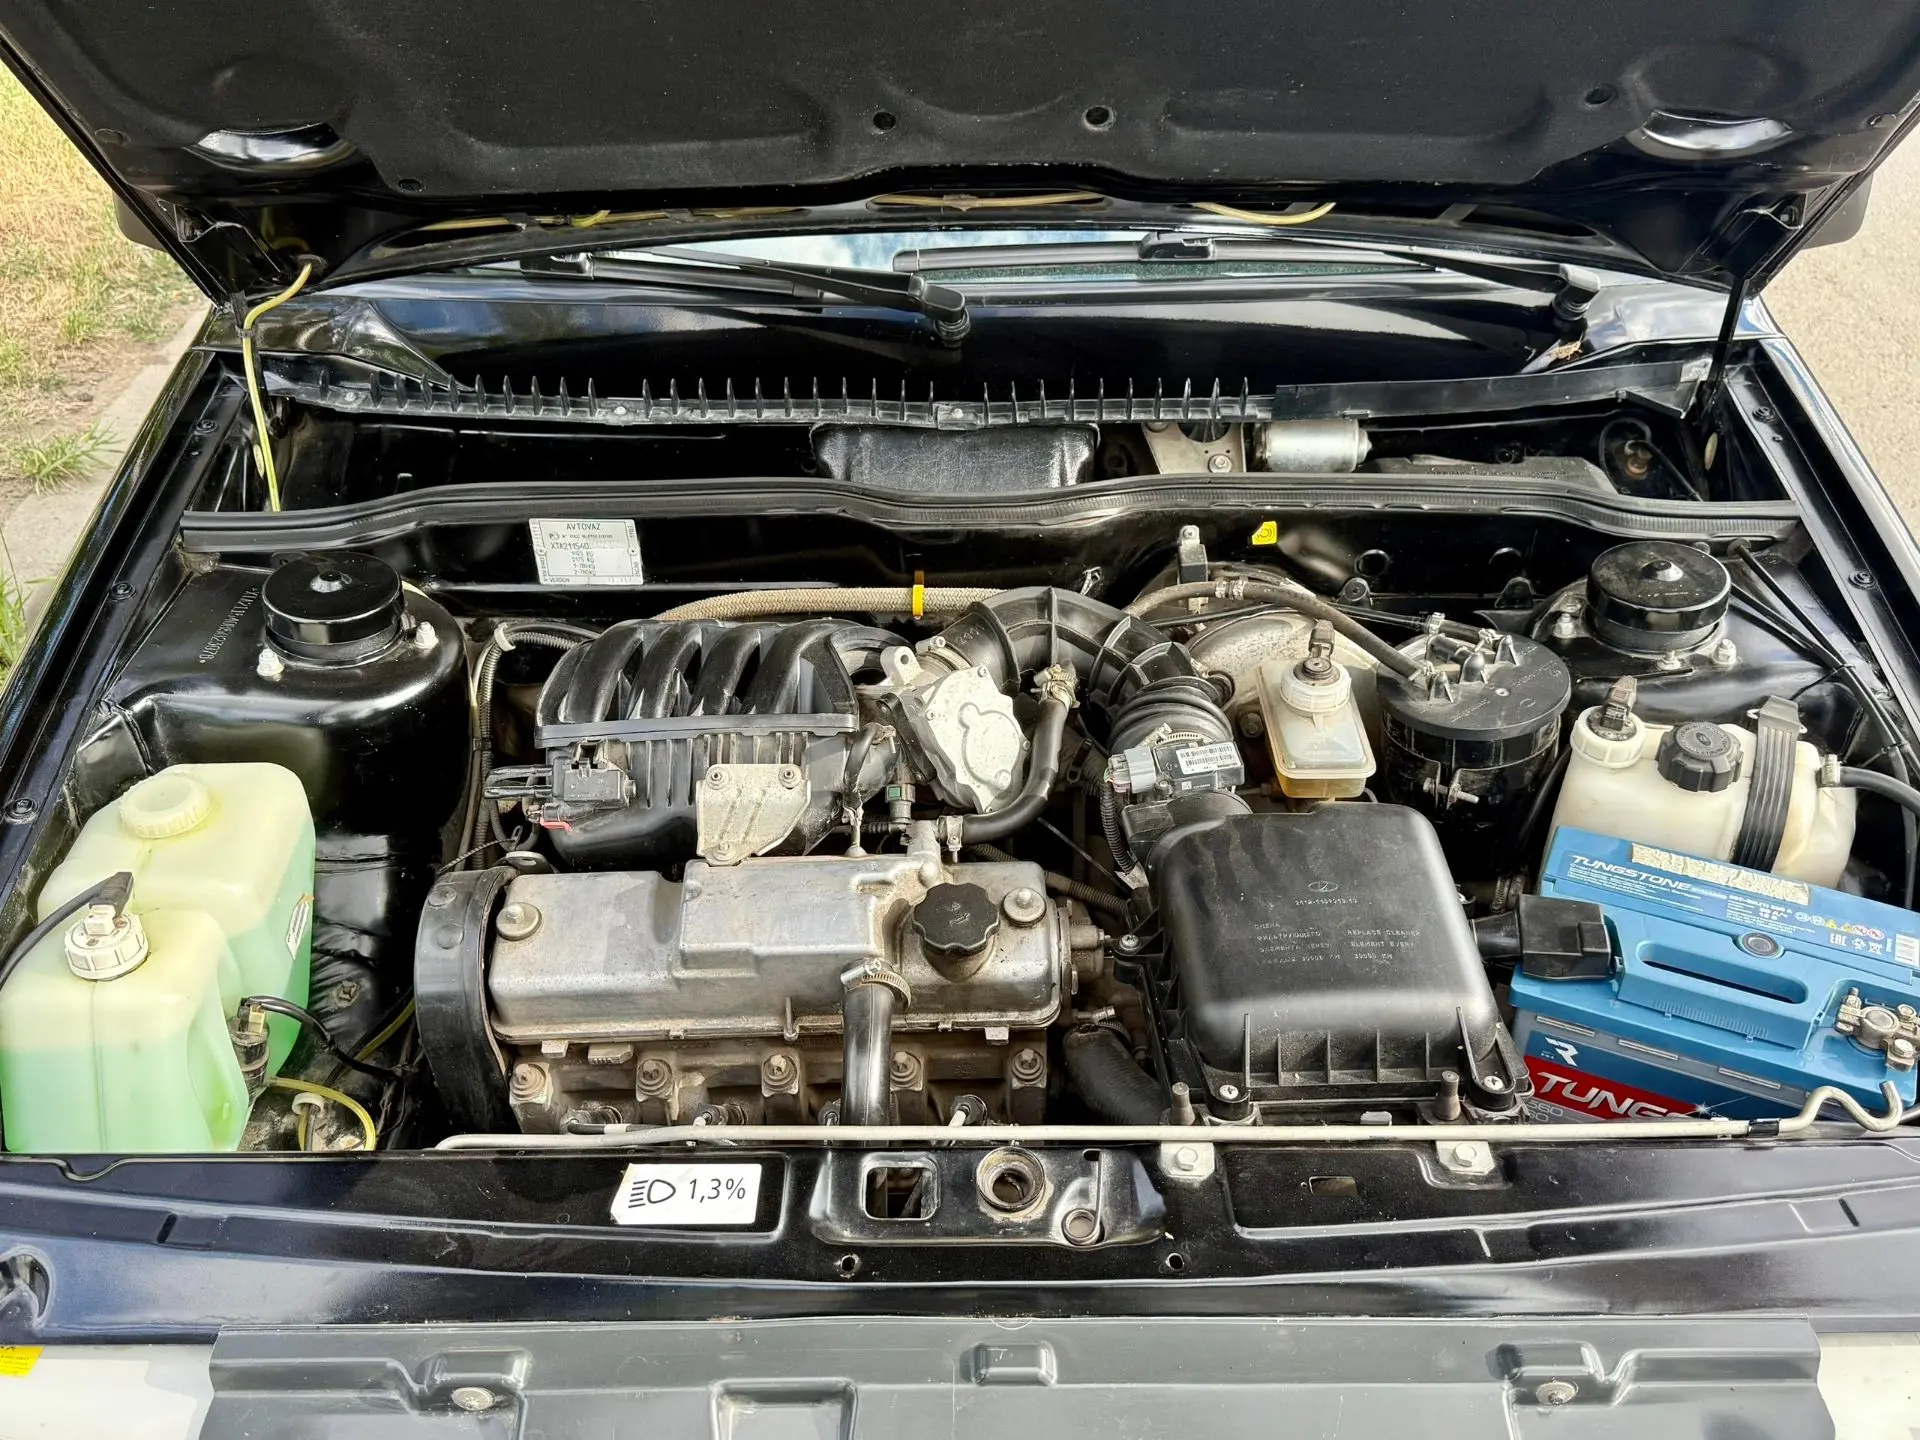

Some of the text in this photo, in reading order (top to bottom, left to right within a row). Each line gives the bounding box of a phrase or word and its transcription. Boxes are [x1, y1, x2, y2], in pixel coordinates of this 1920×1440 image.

[566, 523, 601, 531] AVTOVAZ
[1569, 854, 1692, 891] TUNGSTONE
[1347, 928, 1421, 937] REPLACE CLEANER
[1350, 940, 1385, 948] ELEMENT
[689, 1177, 746, 1203] 1,3%
